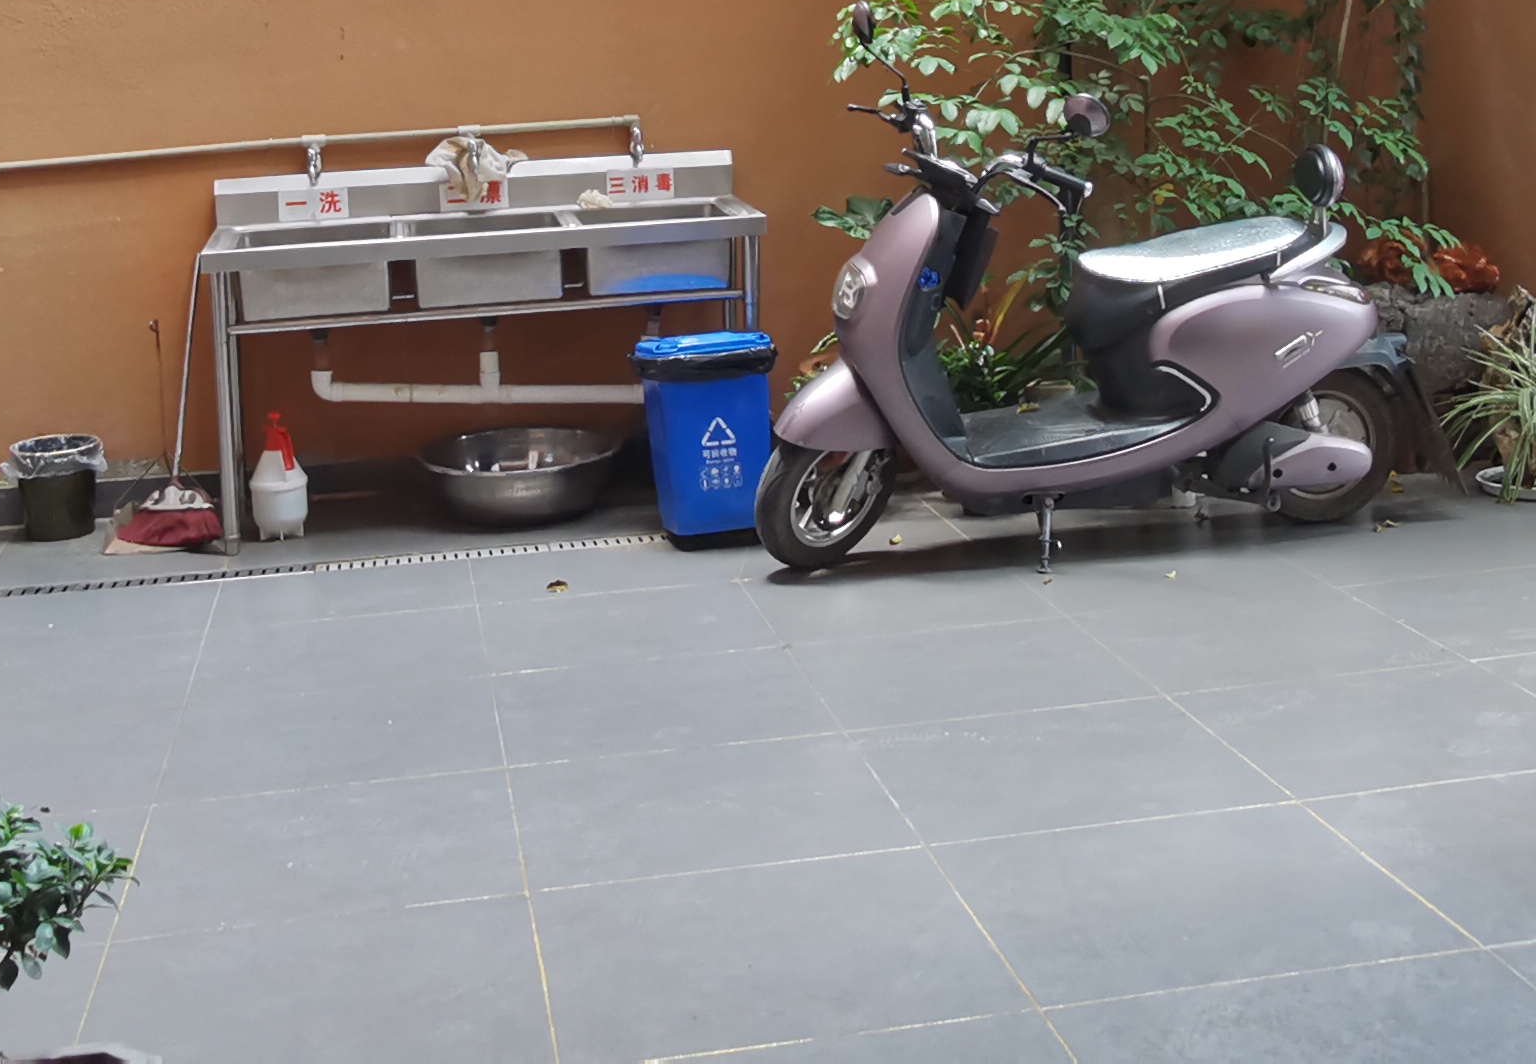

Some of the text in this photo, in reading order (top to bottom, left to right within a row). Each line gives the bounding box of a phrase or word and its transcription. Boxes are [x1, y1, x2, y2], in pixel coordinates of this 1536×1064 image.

[608, 172, 673, 194] 三消毒
[284, 189, 343, 214] 一洗
[702, 447, 738, 459] 可回收物
